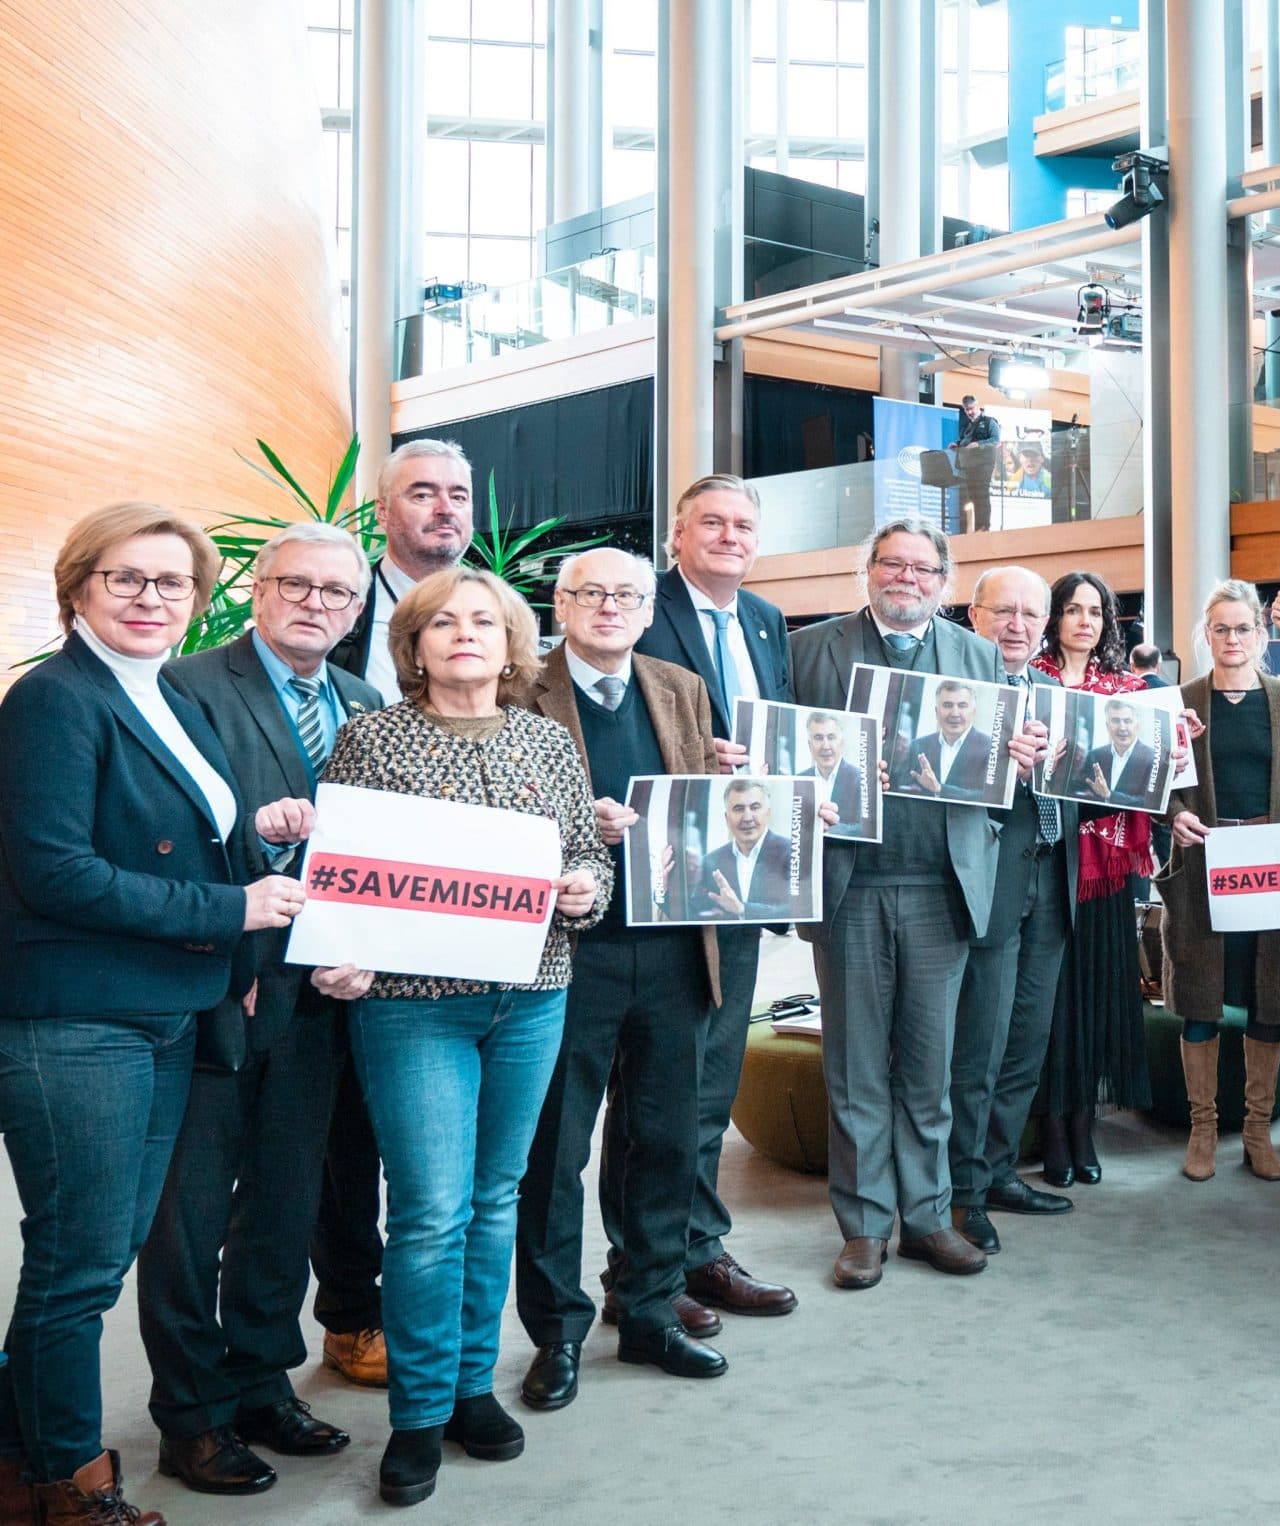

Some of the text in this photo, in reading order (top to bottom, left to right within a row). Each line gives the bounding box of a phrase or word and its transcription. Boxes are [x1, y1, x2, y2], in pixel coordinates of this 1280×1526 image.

[859, 731, 869, 818] #FREESAAKASHVILI
[986, 701, 1006, 785] #FREESAAKASHVILI
[790, 796, 803, 896] #FREESAAKASHVILI
[310, 865, 546, 914] #SAVEMISHA!
